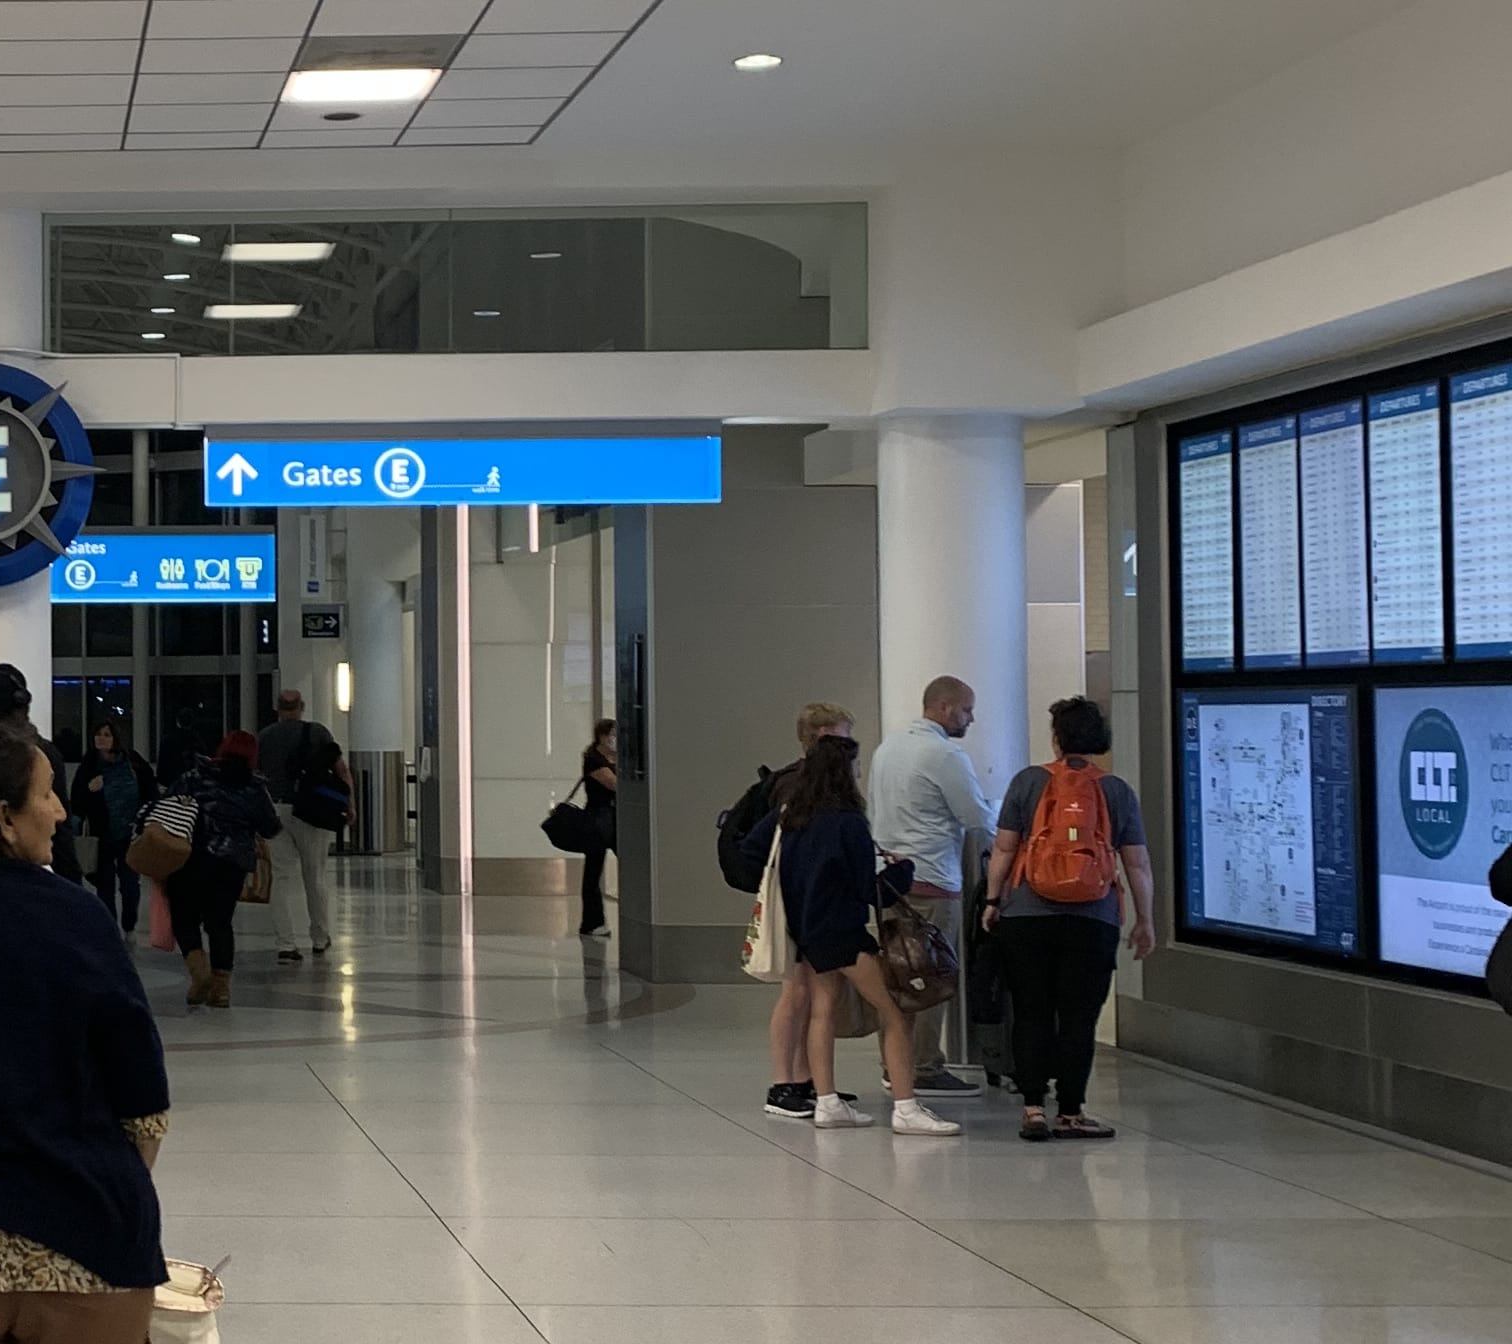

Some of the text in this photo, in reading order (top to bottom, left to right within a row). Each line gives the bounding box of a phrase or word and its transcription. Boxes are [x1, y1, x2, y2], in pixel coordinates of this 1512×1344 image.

[282, 459, 410, 488] Gates E
[66, 540, 106, 555] Gates
[75, 567, 86, 581] E
[1415, 807, 1453, 824] LOCAL
